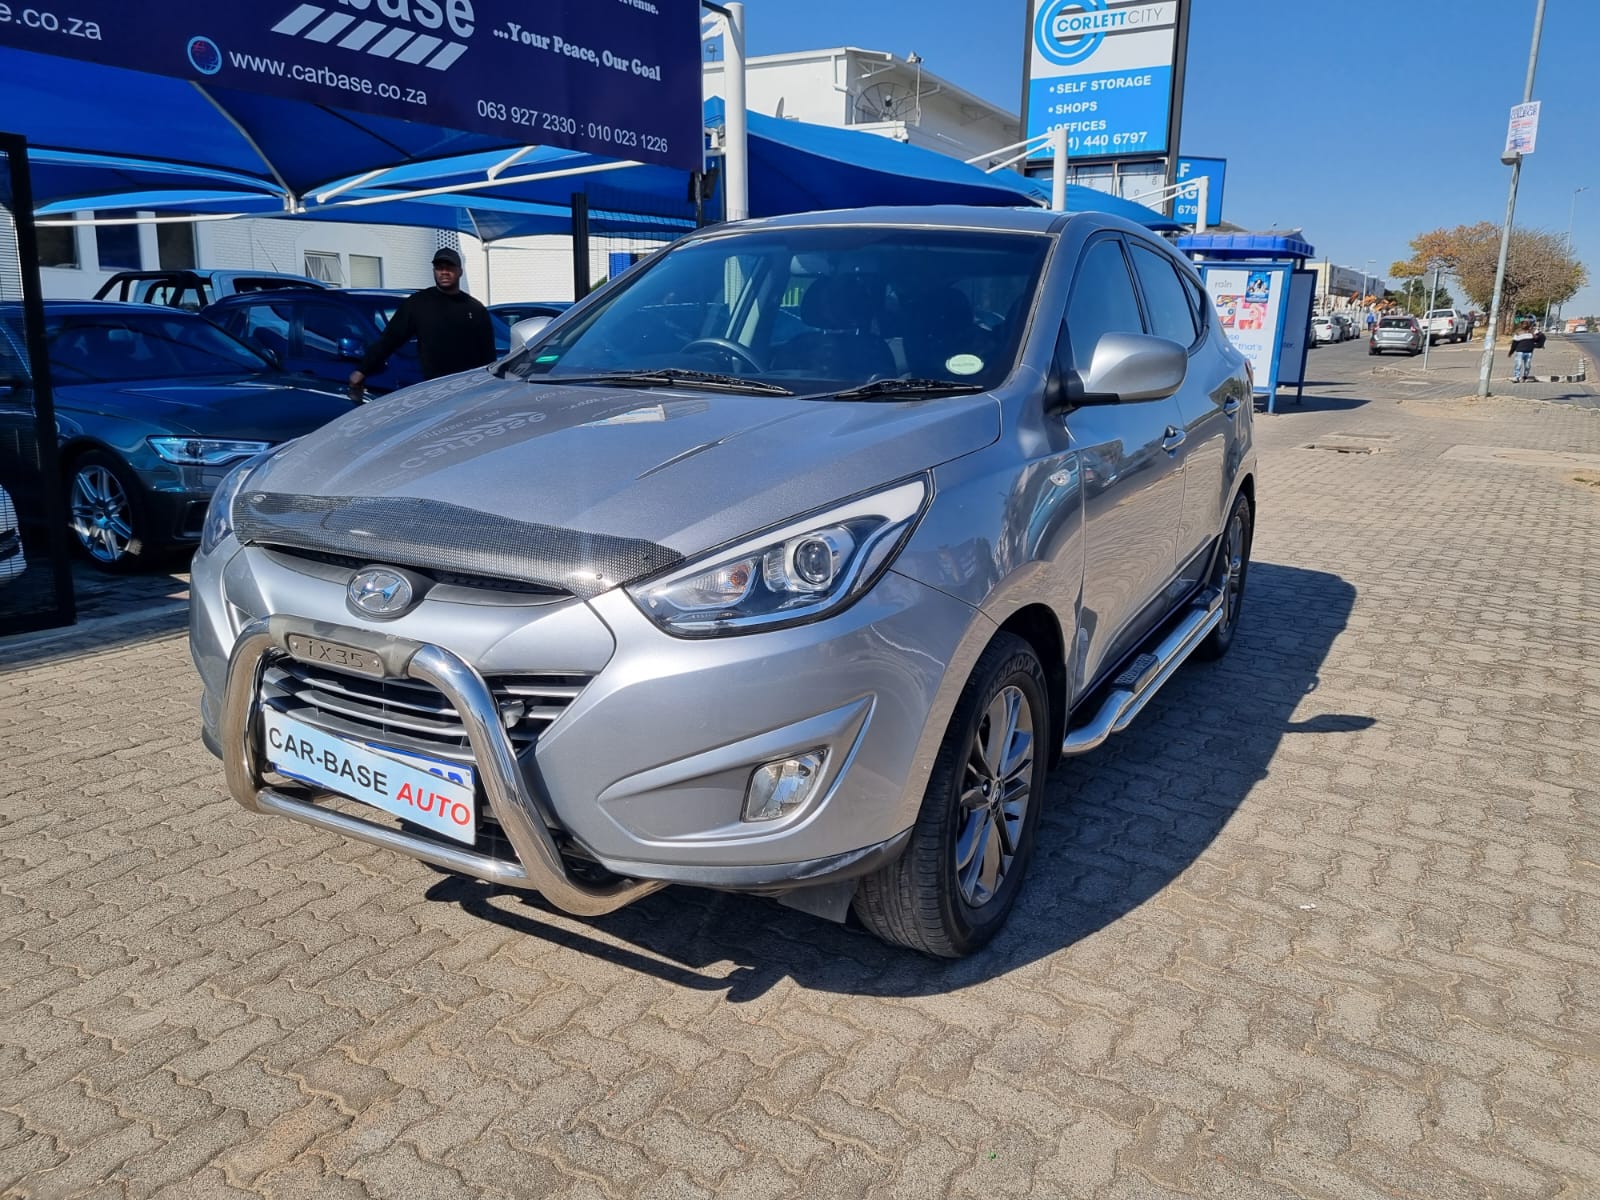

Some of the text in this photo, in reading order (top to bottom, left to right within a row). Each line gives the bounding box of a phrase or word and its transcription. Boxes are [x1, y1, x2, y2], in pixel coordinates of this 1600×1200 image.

[338, 0, 476, 38] ase
[493, 22, 661, 81] ...Your Peace, Our Goal
[229, 50, 428, 106] www.carbase.co.za
[1056, 75, 1152, 94] SELF STORAGE
[477, 100, 507, 121] 063
[511, 107, 538, 126] 927
[542, 112, 577, 135] 2330
[588, 122, 611, 142] 010
[614, 128, 637, 147] 023
[640, 134, 668, 153] 1226
[1055, 101, 1098, 114] SHOPS
[1083, 135, 1109, 147] 440
[1113, 131, 1148, 145] 6797
[1214, 280, 1232, 288] rain
[269, 727, 472, 826] CAR-BASE AUTO
